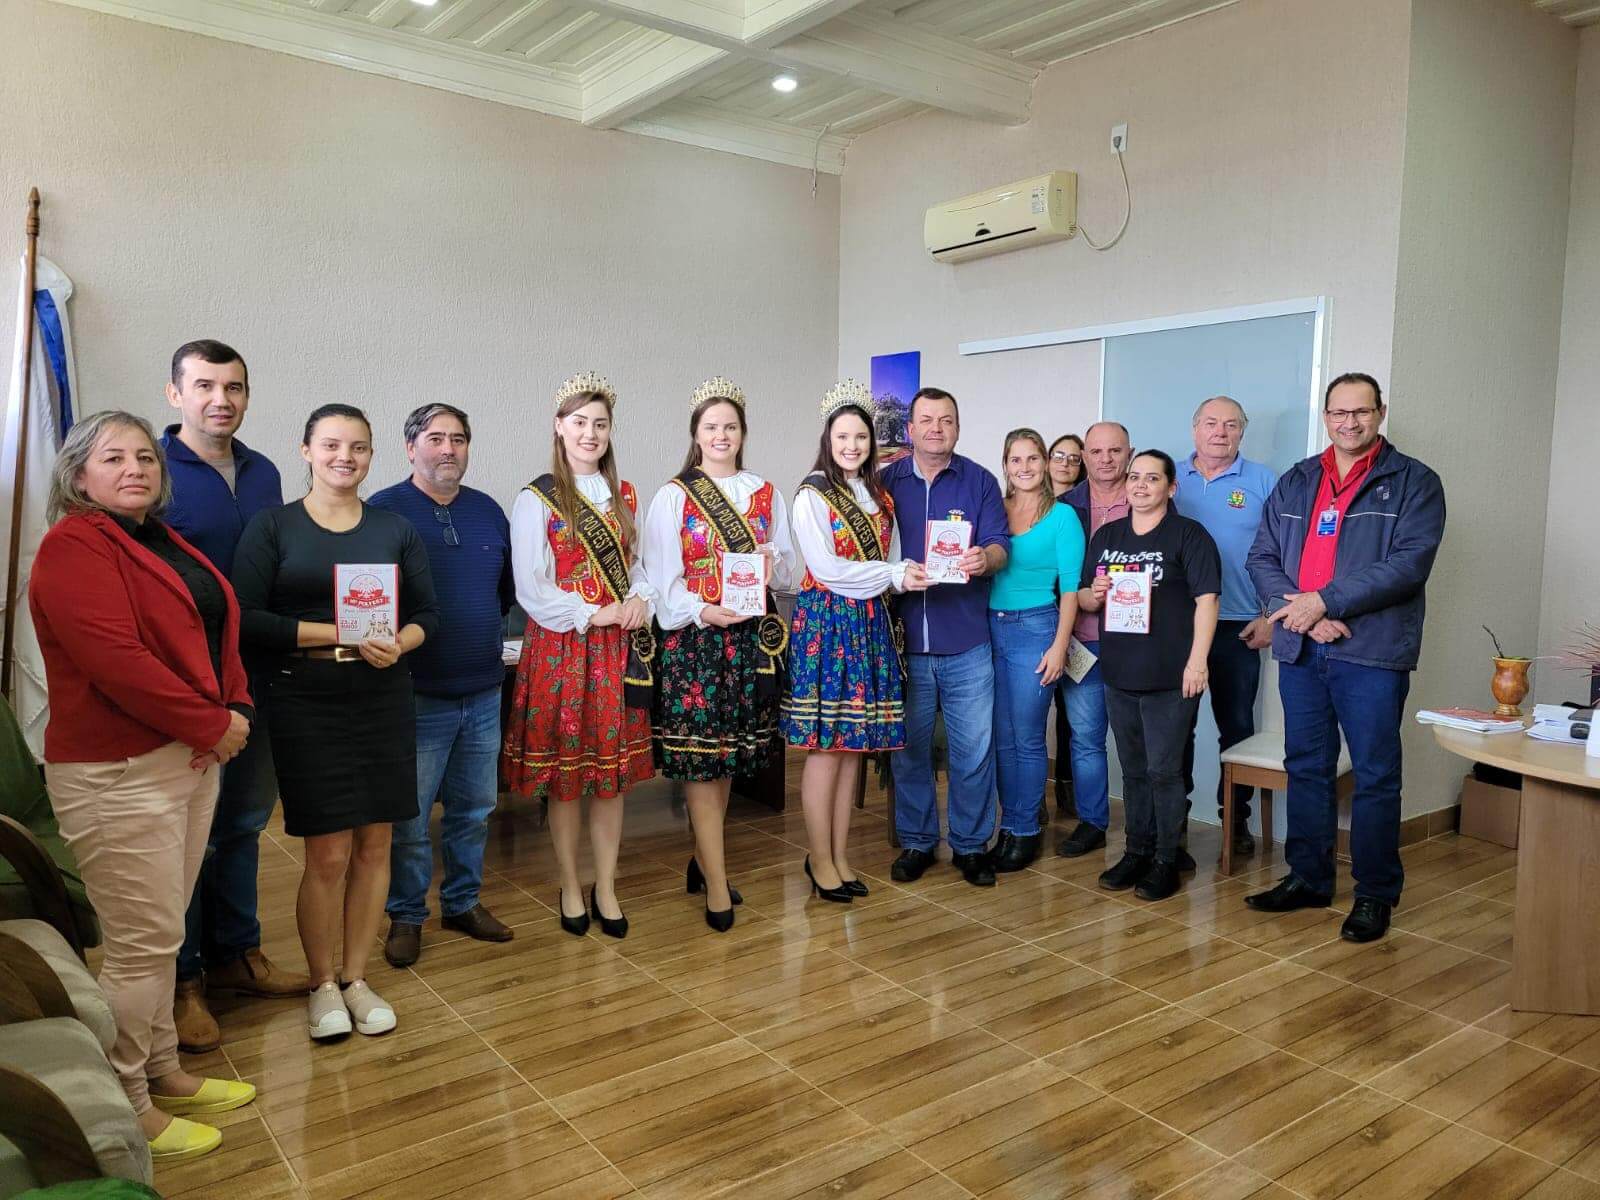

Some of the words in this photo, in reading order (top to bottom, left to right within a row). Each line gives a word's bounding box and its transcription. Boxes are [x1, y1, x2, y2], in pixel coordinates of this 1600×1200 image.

[580, 515, 614, 553] POLFEST
[718, 508, 747, 542] POLFEST
[849, 512, 875, 547] POLFEST
[1098, 549, 1164, 563] Missões
